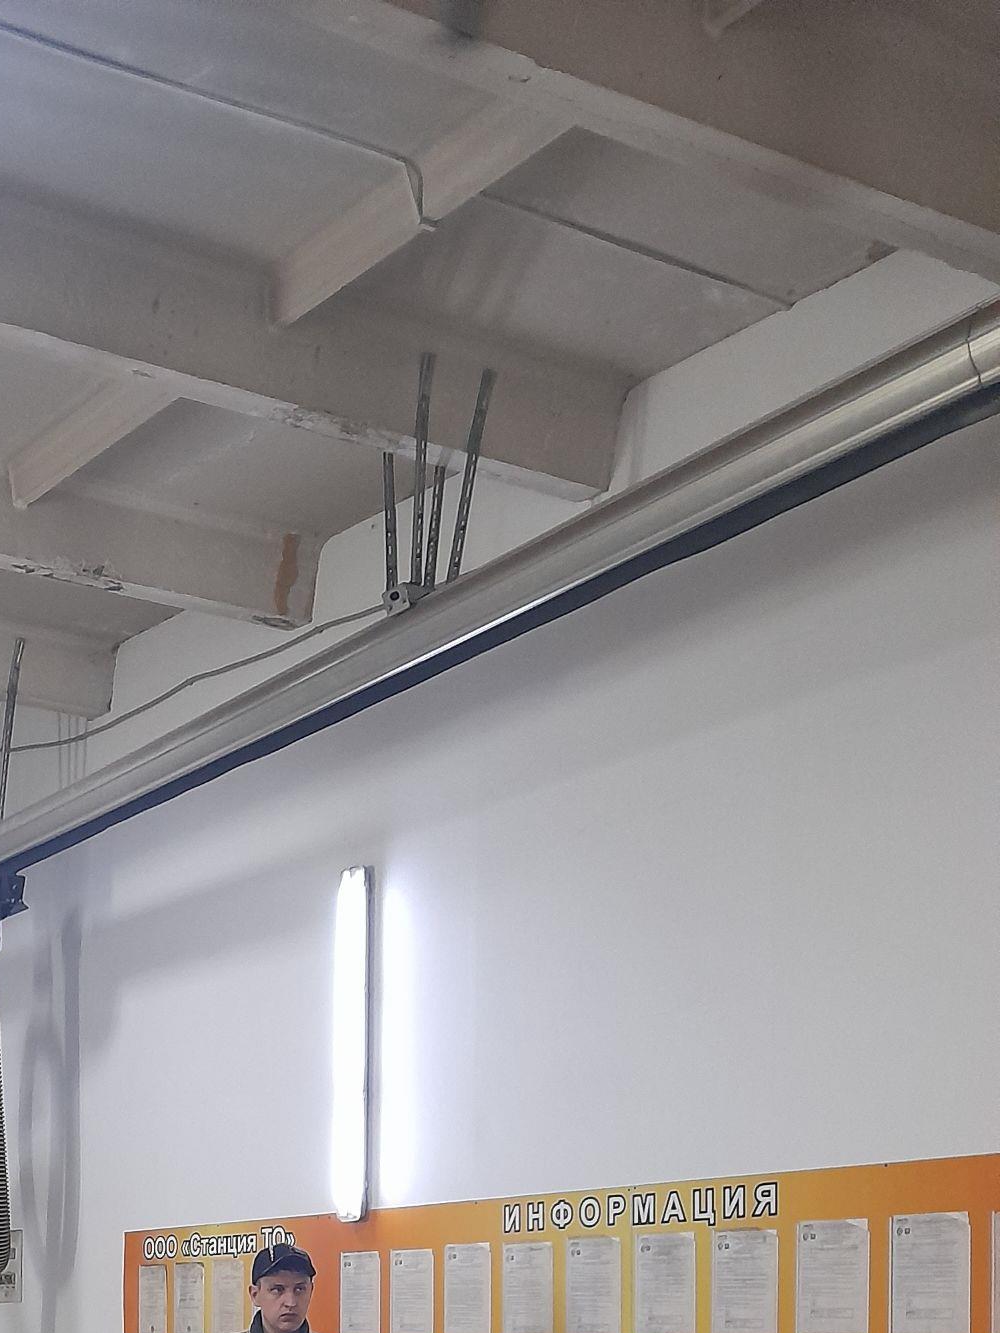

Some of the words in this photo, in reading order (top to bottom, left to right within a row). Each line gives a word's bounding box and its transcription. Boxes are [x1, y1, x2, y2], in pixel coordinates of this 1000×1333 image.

[502, 1181, 780, 1234] ИНФОРМАЦИЯ
[143, 1234, 178, 1260] ООО
[181, 1231, 258, 1258] «Станция
[260, 1225, 296, 1250] ТО»
